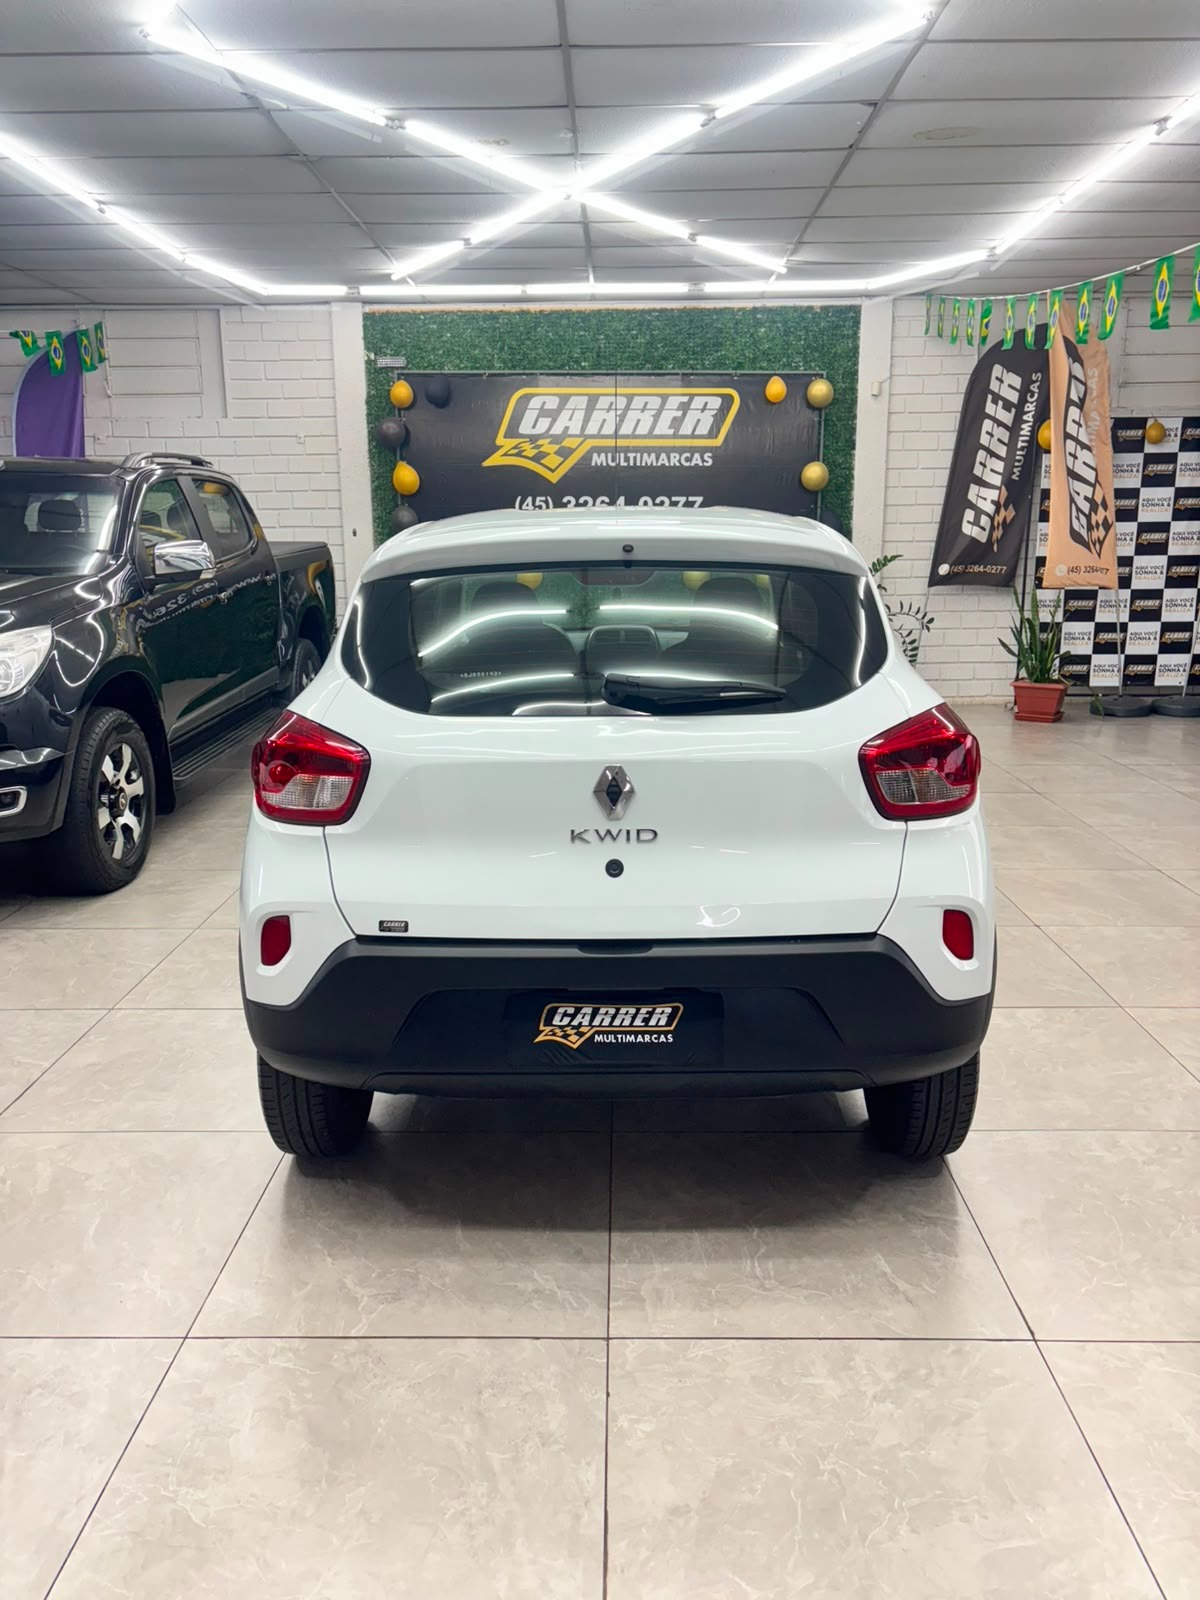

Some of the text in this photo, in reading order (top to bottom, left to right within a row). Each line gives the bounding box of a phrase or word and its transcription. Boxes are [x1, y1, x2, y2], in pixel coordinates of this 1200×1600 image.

[518, 395, 722, 435] CARRER
[1011, 372, 1042, 480] MULTIMARCAS
[592, 453, 713, 466] MULTIMARCAS
[961, 363, 1022, 543] CARRER
[965, 565, 1007, 574] 3264-0277
[570, 829, 658, 844] KWID
[552, 1006, 672, 1026] CARRER
[594, 1033, 674, 1043] MULTIMARCAS
